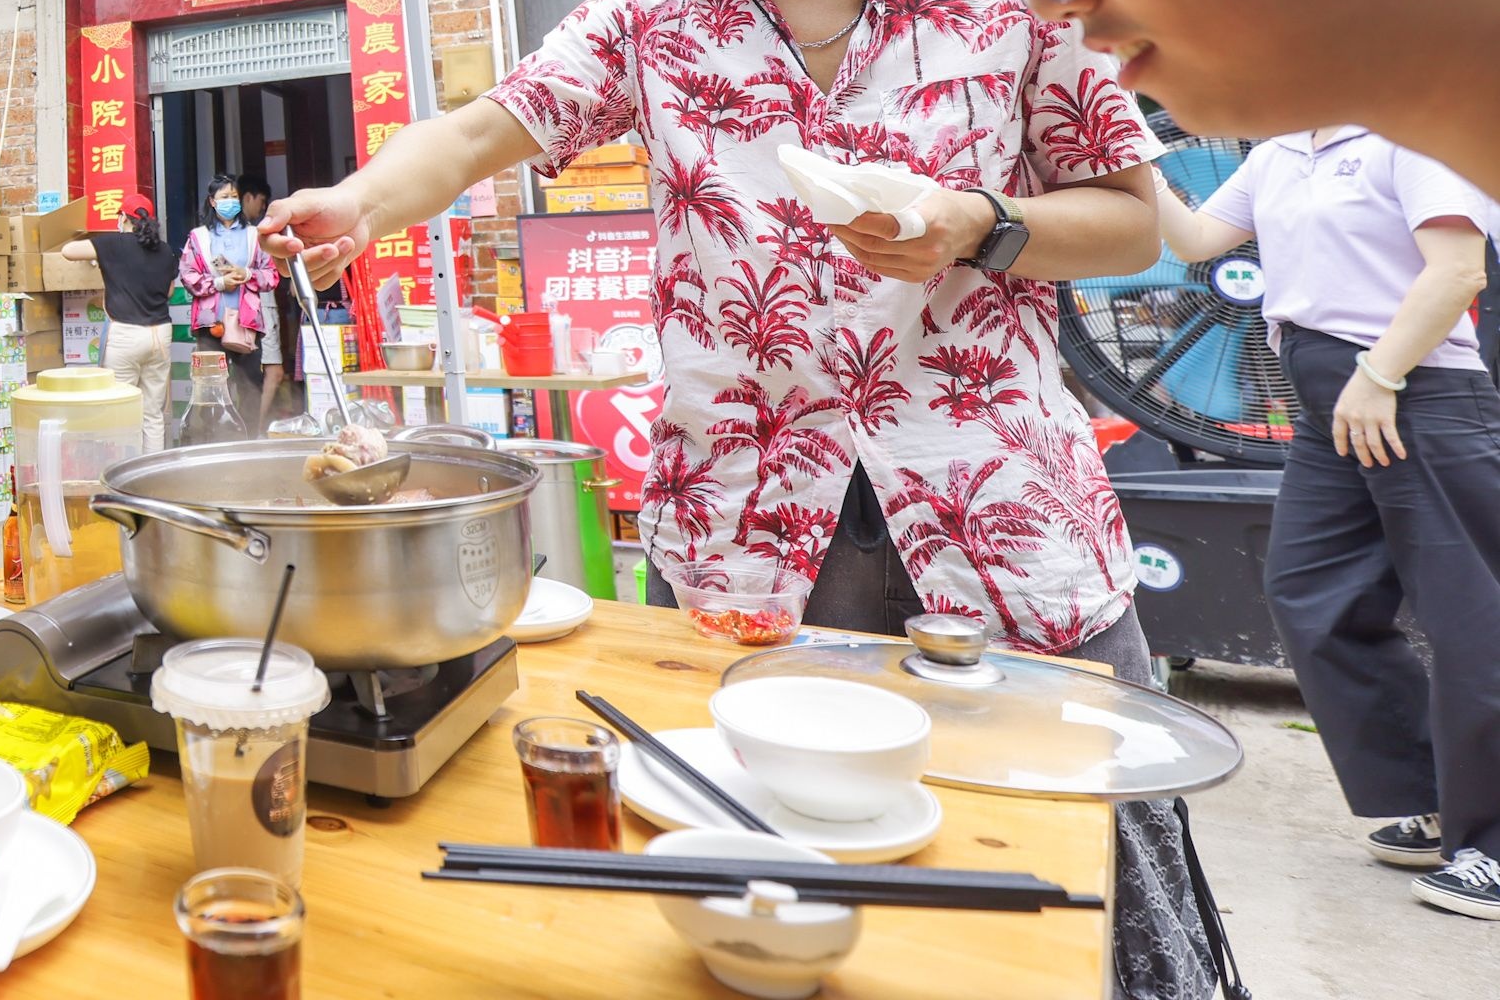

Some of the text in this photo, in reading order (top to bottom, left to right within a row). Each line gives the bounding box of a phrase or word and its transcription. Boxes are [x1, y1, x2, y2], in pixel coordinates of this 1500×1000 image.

[90, 53, 126, 222] 小院酒香
[466, 521, 487, 536] 32CM
